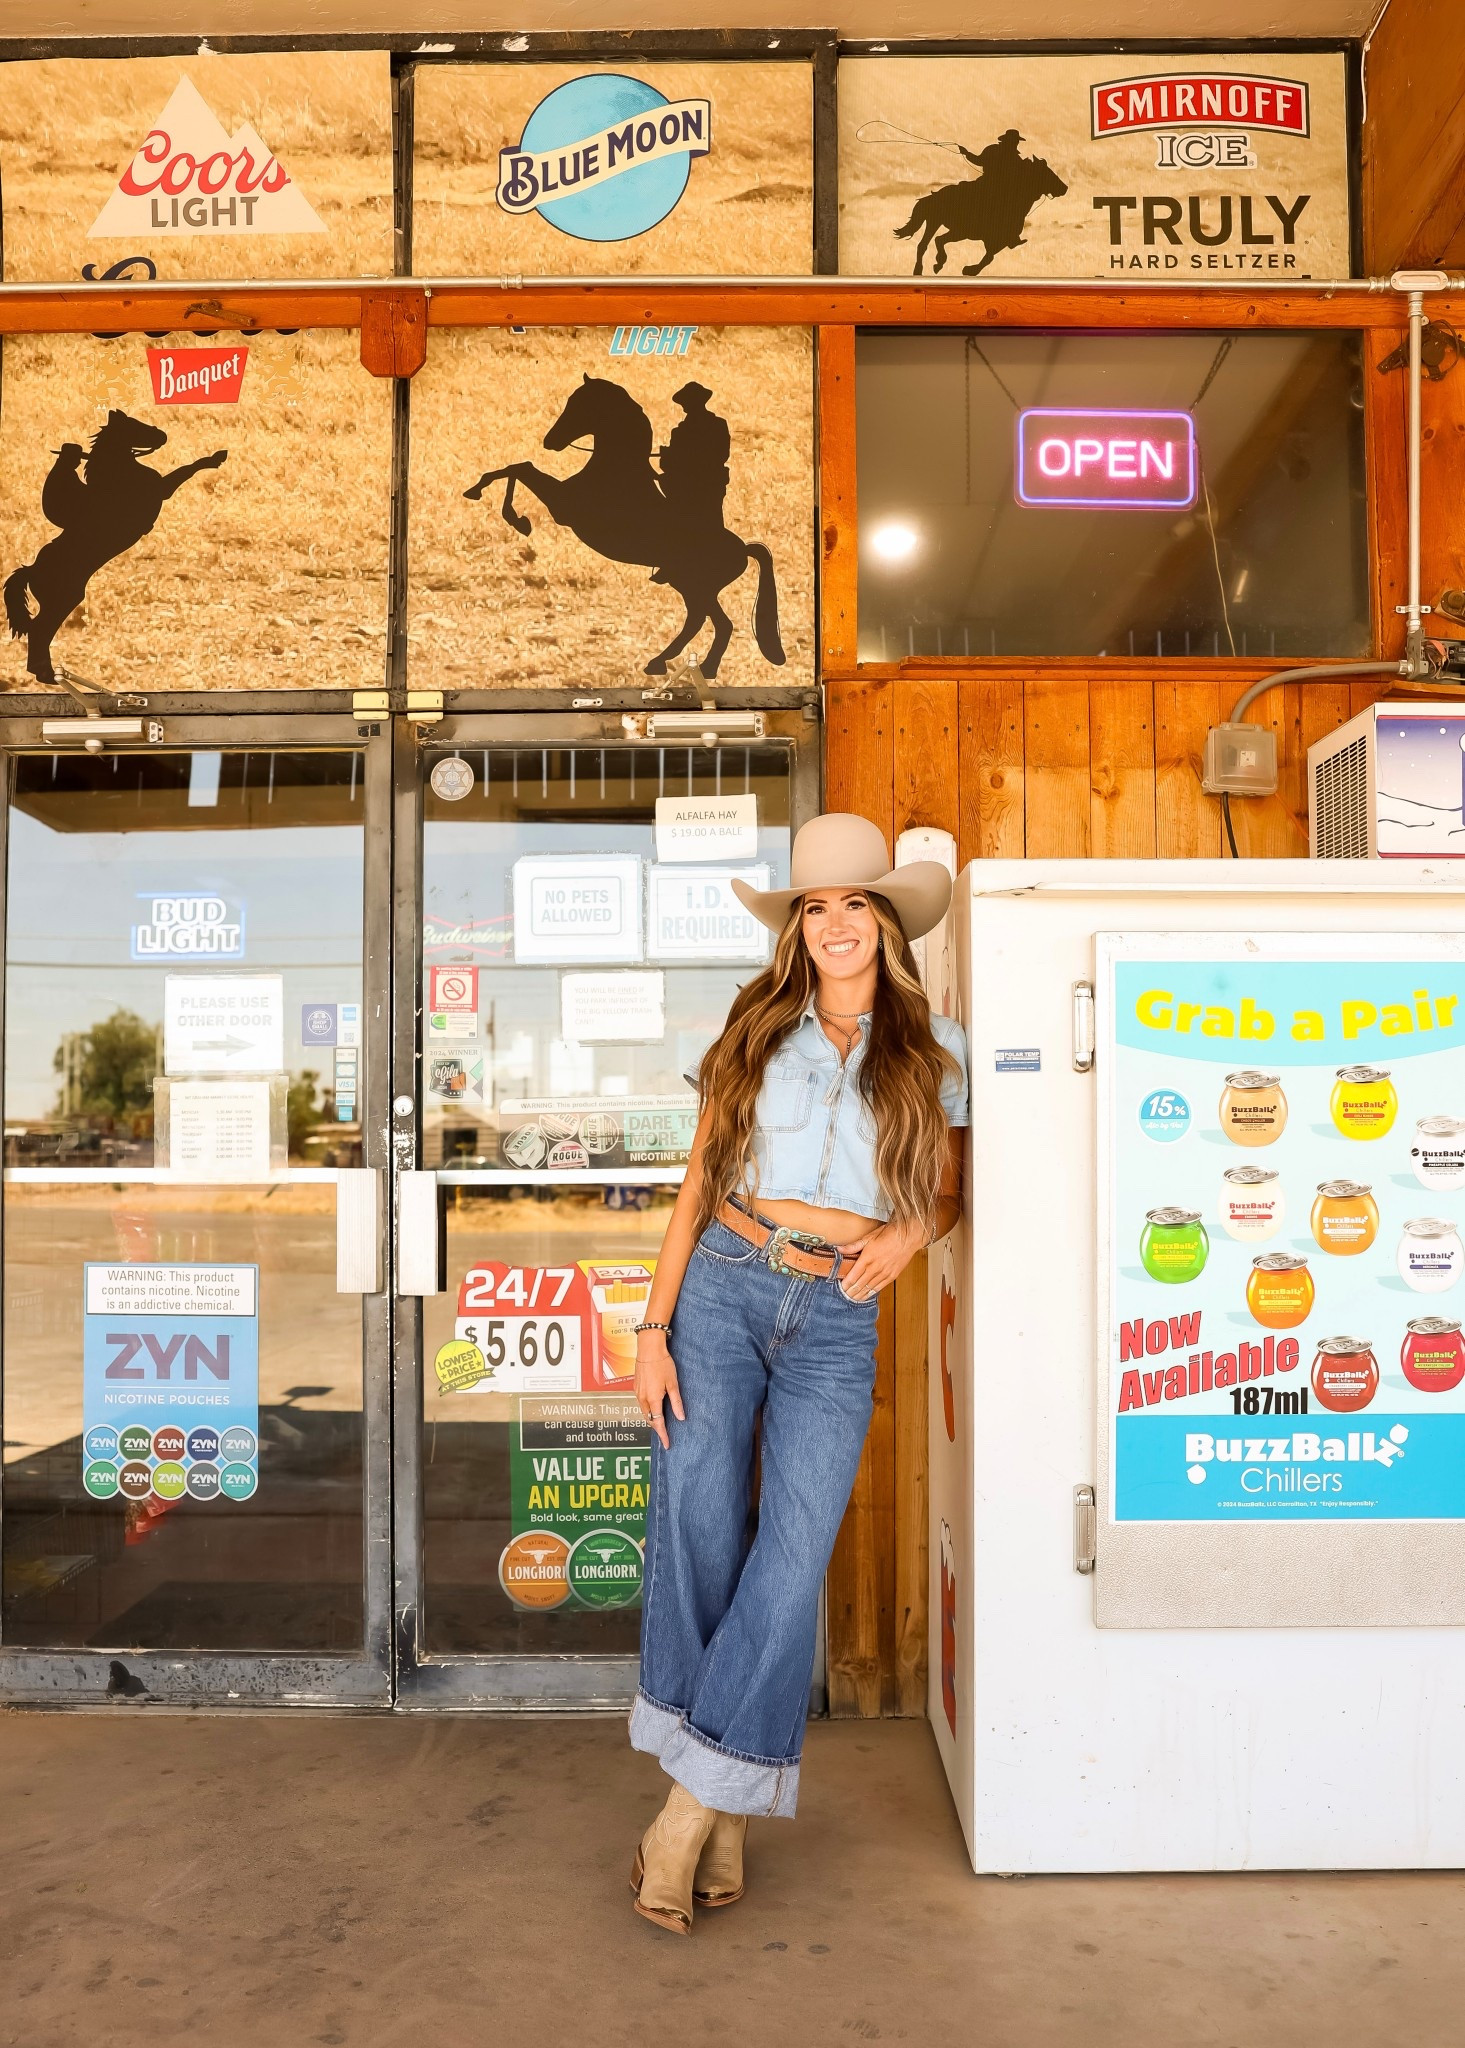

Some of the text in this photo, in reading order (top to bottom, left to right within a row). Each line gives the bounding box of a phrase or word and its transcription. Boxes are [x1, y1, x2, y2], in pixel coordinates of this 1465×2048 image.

[1106, 84, 1293, 125] SMIRNOFF
[502, 109, 703, 206] BLUE MOON
[1157, 136, 1248, 166] ICE
[119, 130, 291, 195] Coors
[151, 196, 259, 227] LIGHT
[1093, 195, 1311, 245] TRULY
[1111, 254, 1297, 268] HARD SELTZER
[608, 326, 697, 356] LIGHT
[160, 354, 240, 399] Banquet
[1038, 438, 1173, 479] OPEN
[676, 810, 738, 821] ALFALFA HAY
[710, 828, 716, 836] A
[719, 827, 743, 836] BALE
[545, 890, 609, 904] NO PETS
[687, 885, 730, 910] I.D.
[152, 898, 227, 927] BUD
[541, 908, 613, 923] ALLOWED
[662, 914, 755, 942] REQUIRED
[137, 924, 241, 953] LIGHT
[180, 996, 269, 1009] PLEASE USE
[177, 1014, 272, 1027] OTHER DOOR
[1135, 988, 1458, 1041] Grab a Pair
[338, 1080, 355, 1088] VISA
[1149, 1095, 1186, 1117] 15%
[629, 1115, 672, 1131] DARE
[588, 1118, 599, 1149] ROGUE
[629, 1131, 684, 1148] MORE.
[553, 1151, 583, 1162] ROGUE
[630, 1151, 677, 1162] NICOTINE
[107, 1270, 234, 1284] WARNING: This product
[598, 1269, 644, 1277] 24/7
[102, 1286, 240, 1297] contains nicotine. Nicotine
[465, 1268, 575, 1308] 24/7
[107, 1299, 235, 1311] is an addictive chemical.
[618, 1317, 637, 1325] RED
[1119, 1310, 1202, 1362] Now
[105, 1333, 230, 1380] ZYN
[438, 1348, 477, 1370] LOWEST
[447, 1361, 476, 1377] PRICE
[1118, 1336, 1300, 1413] Available
[104, 1394, 230, 1405] NICOTINE POUCHES
[1229, 1387, 1308, 1415] 187ml
[541, 1404, 596, 1416] WARNING:
[600, 1404, 620, 1415] This
[544, 1420, 563, 1429] can
[566, 1420, 594, 1429] cause
[598, 1420, 619, 1431] gum
[91, 1437, 251, 1450] ZYN ZYN ZYN ZYN ZYN
[566, 1431, 638, 1443] and tooth loss.
[90, 1472, 251, 1484] ZYN ZYN ZYN ZYN ZYN
[532, 1457, 605, 1481] VALUE
[1240, 1468, 1343, 1493] Chillers
[528, 1484, 651, 1509] AN UPGRA
[531, 1512, 643, 1524] Bold look, same great
